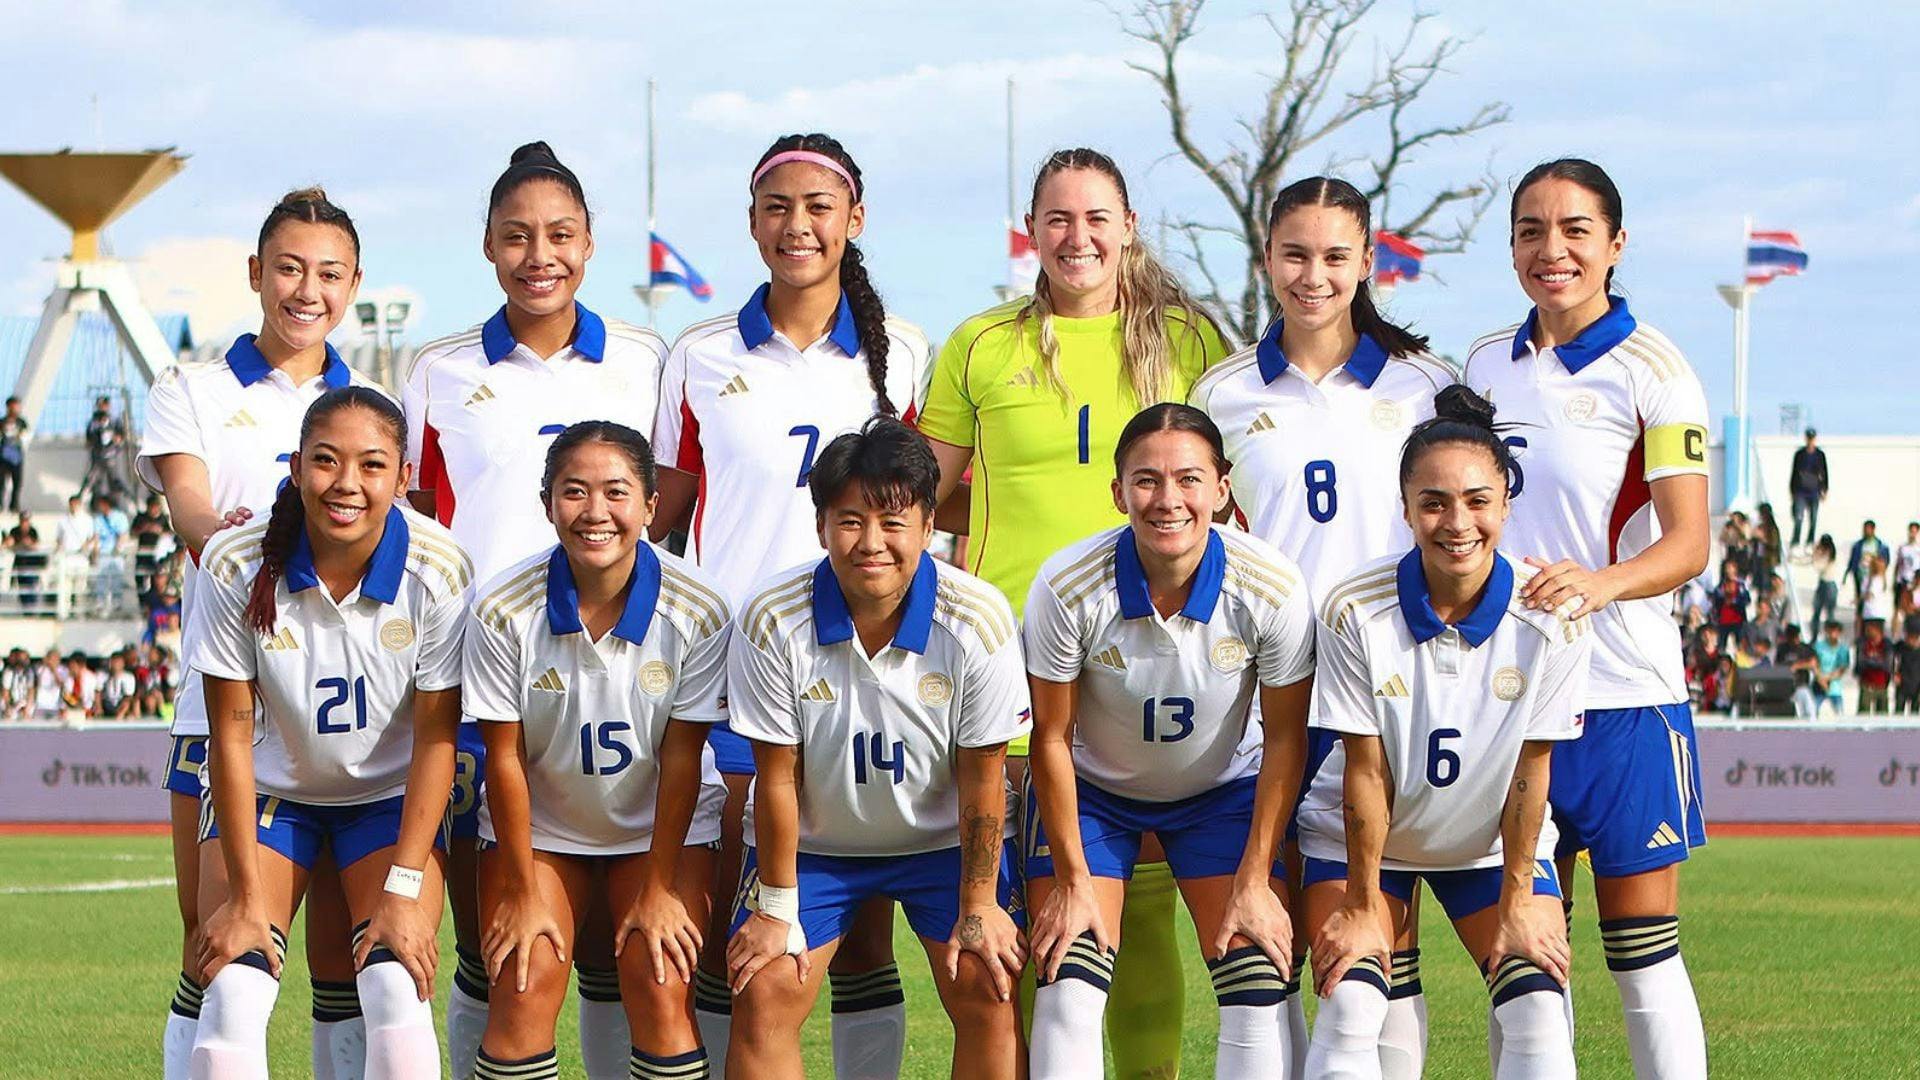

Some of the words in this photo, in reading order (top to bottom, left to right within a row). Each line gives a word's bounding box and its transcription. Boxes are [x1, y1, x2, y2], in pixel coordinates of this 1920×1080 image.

[788, 425, 820, 487] 7
[1078, 404, 1091, 464] 1
[1684, 429, 1703, 462] C
[1304, 459, 1338, 523] 8
[315, 675, 367, 735] 21
[1142, 696, 1195, 743] 13
[70, 763, 152, 786] TikTok
[580, 721, 633, 776] 15
[852, 731, 911, 785] 14
[1426, 728, 1463, 788] 6
[1754, 763, 1835, 787] TikTok
